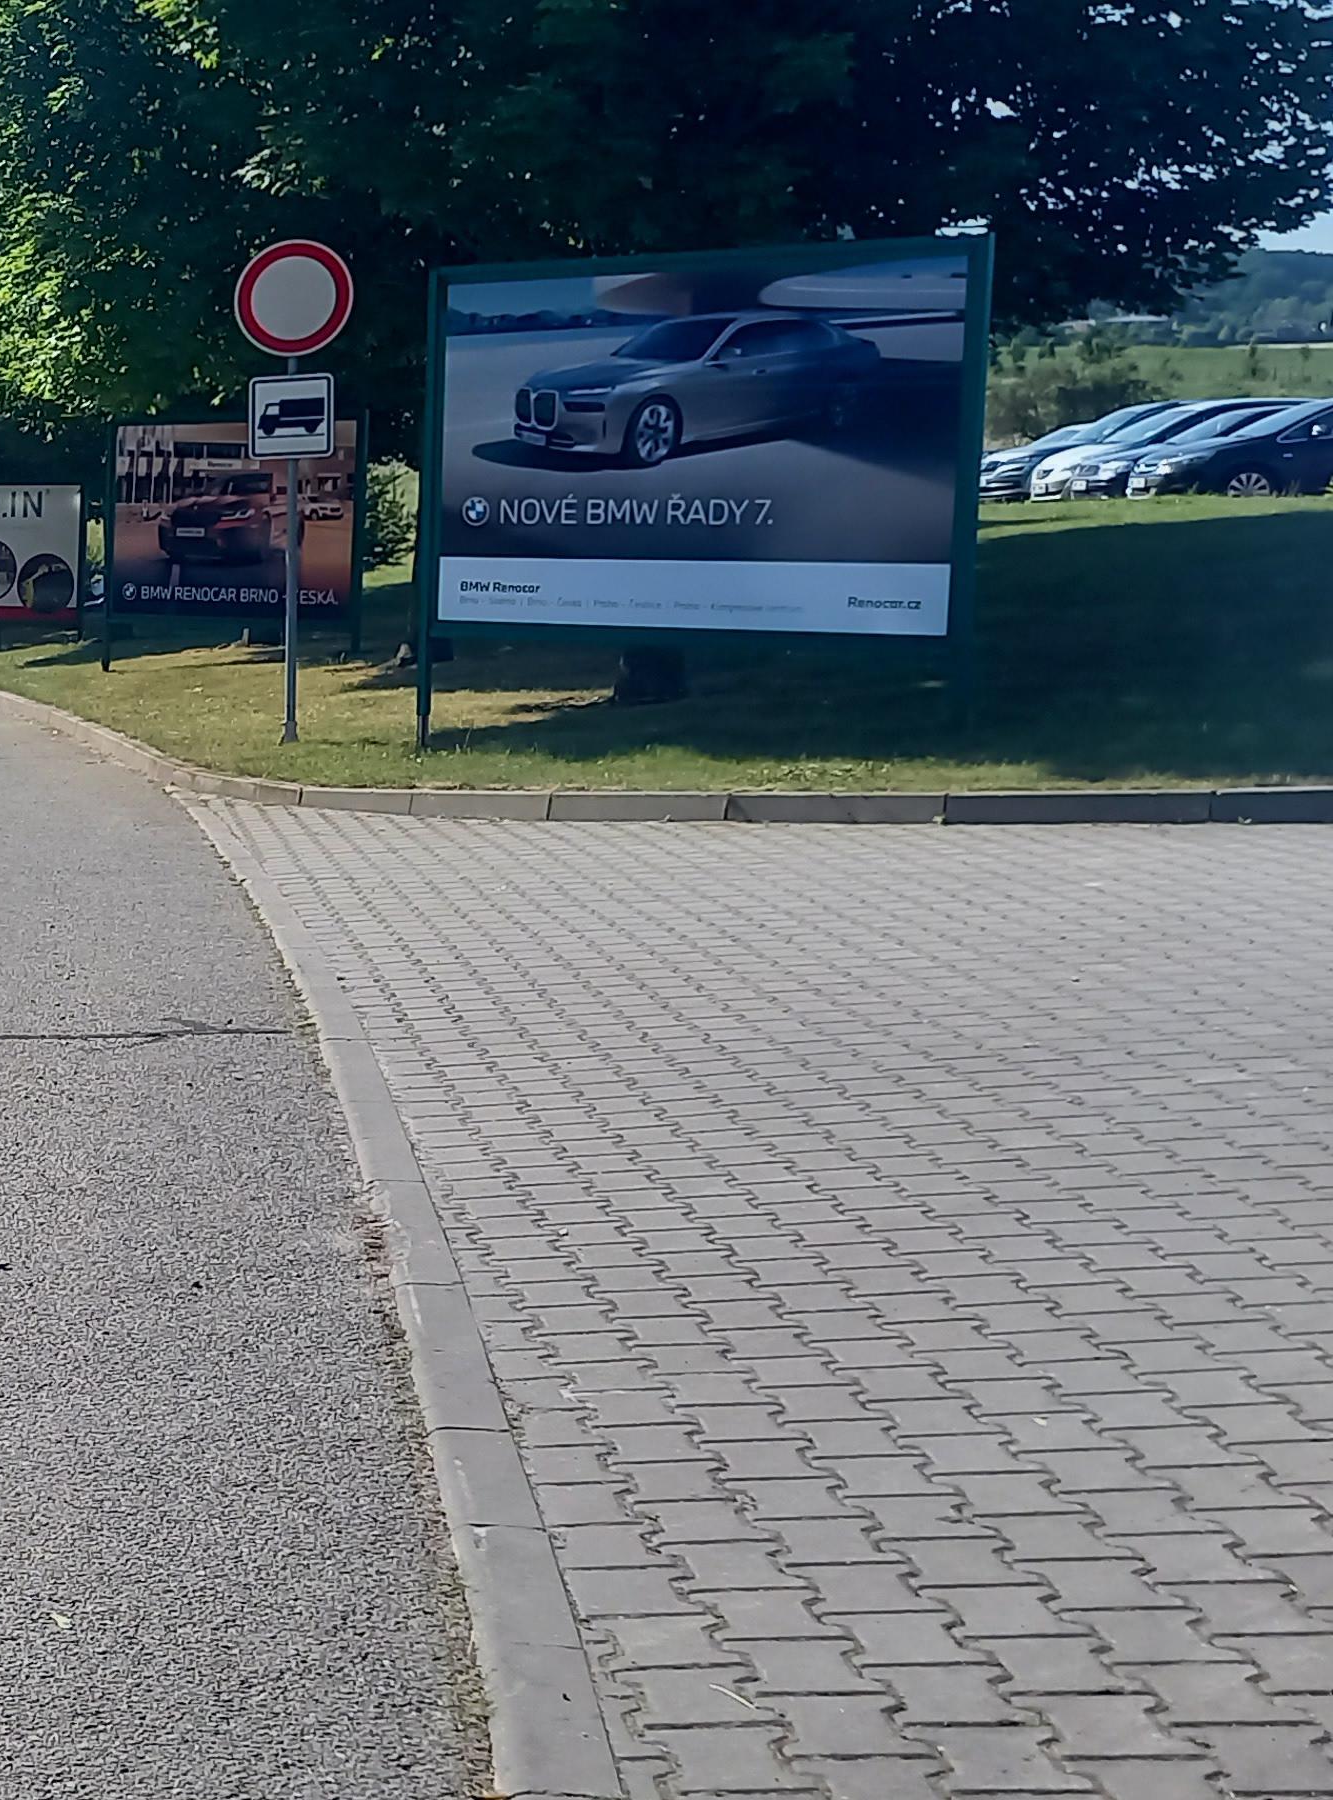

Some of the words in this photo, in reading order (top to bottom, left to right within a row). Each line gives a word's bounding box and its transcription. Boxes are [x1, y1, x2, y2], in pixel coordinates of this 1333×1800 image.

[500, 494, 577, 526] NOVÉ
[586, 499, 658, 526] BMW
[666, 494, 750, 526] ŘADY
[754, 499, 774, 526] 7.
[140, 585, 172, 600] BMW
[174, 586, 237, 602] RENOCAR
[239, 588, 279, 604] BRNO
[459, 580, 491, 592] BMW
[492, 581, 541, 594] Renocar
[847, 596, 923, 610] Renocar.cz
